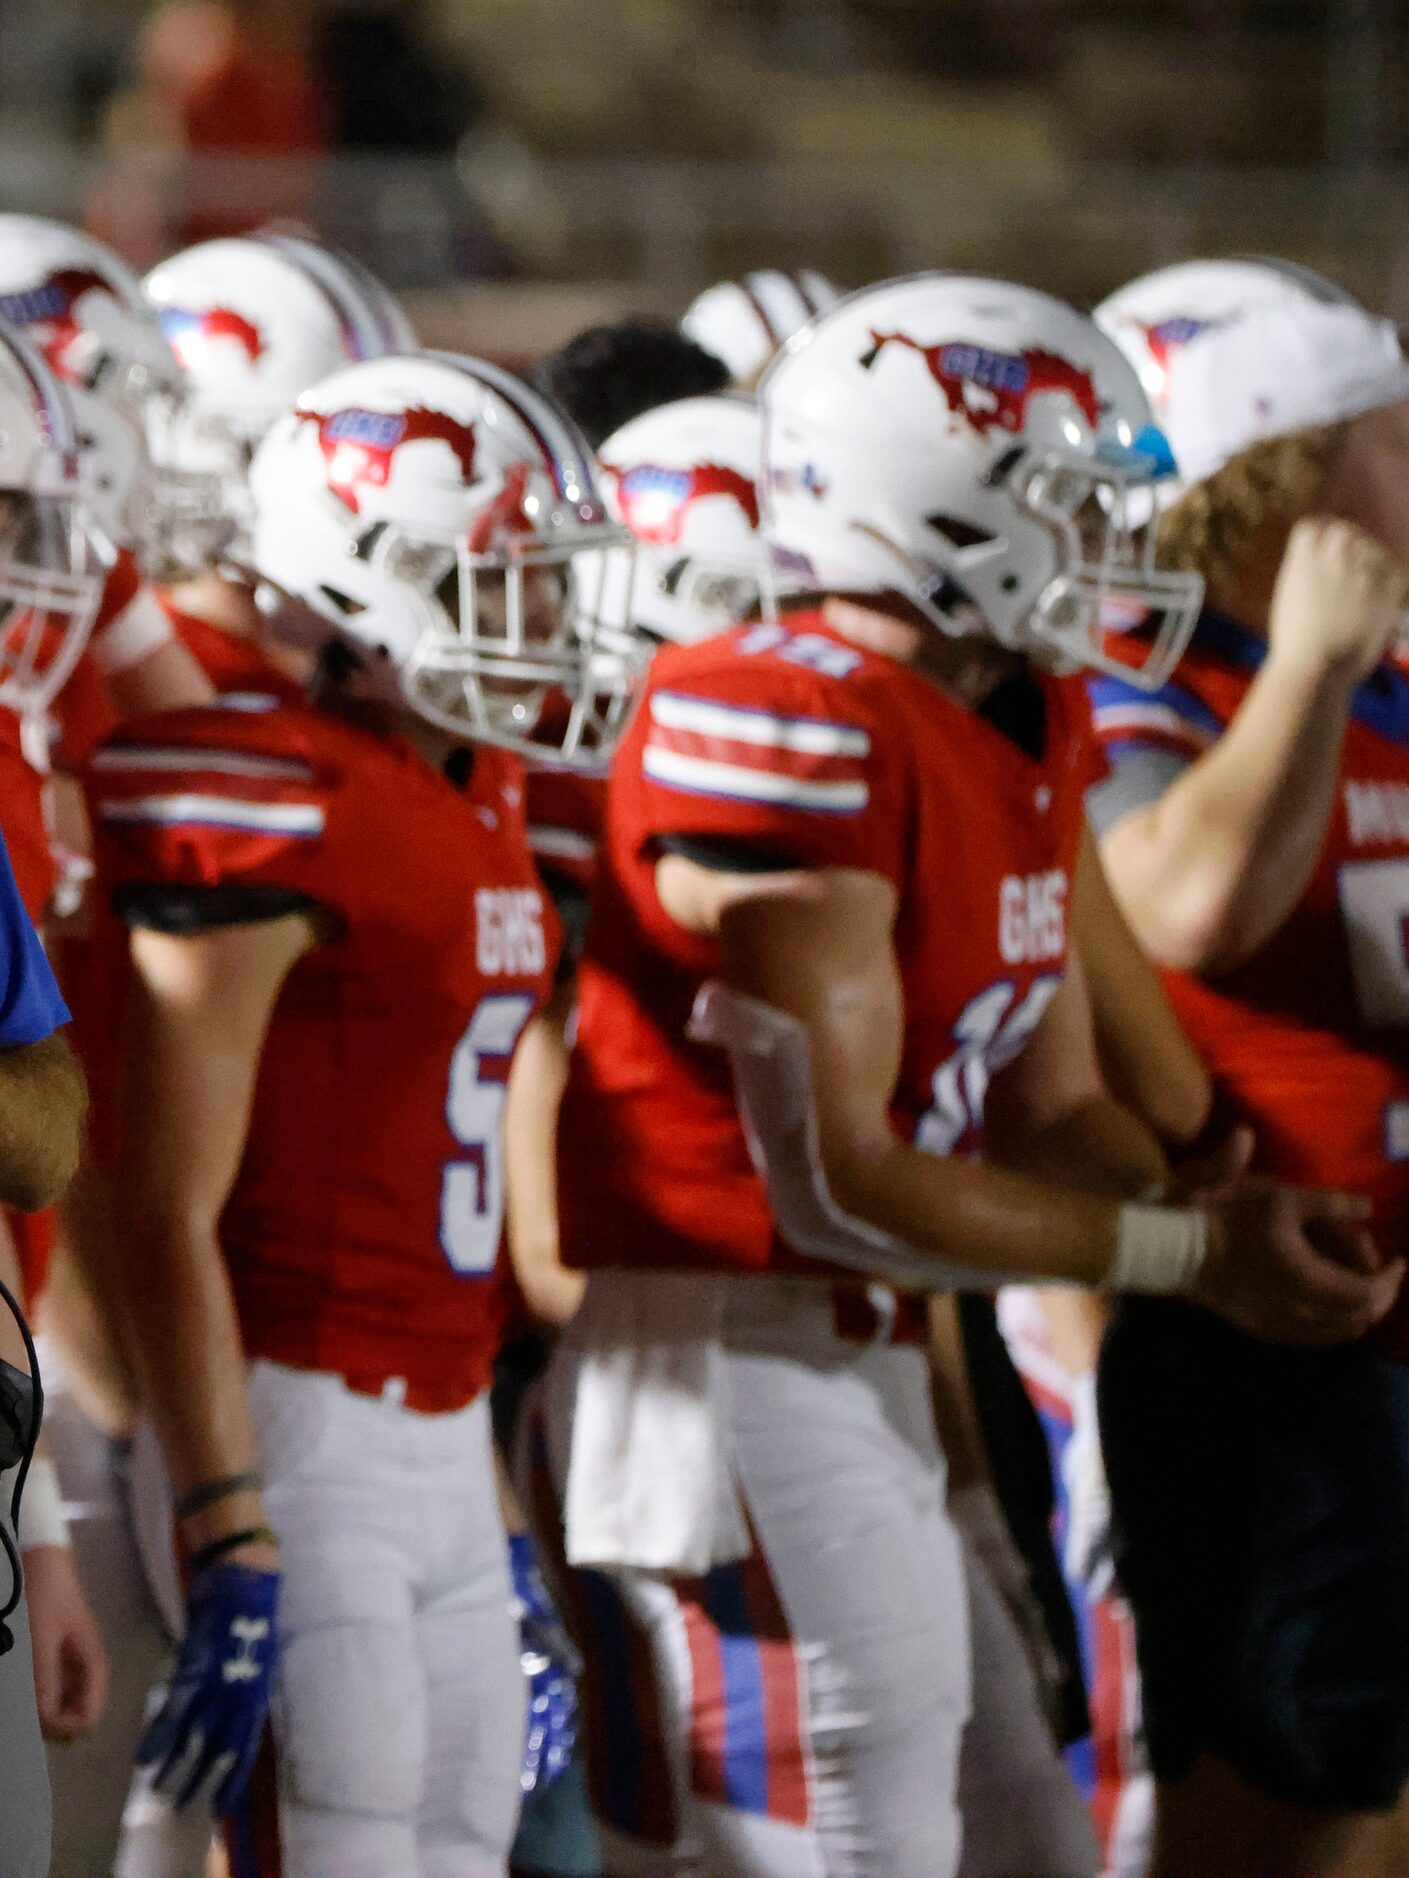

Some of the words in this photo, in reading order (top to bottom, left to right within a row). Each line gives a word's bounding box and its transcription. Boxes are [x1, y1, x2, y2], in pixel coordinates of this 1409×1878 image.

[474, 886, 548, 978] GHS
[997, 867, 1069, 964] GHS
[437, 992, 536, 1283] 5
